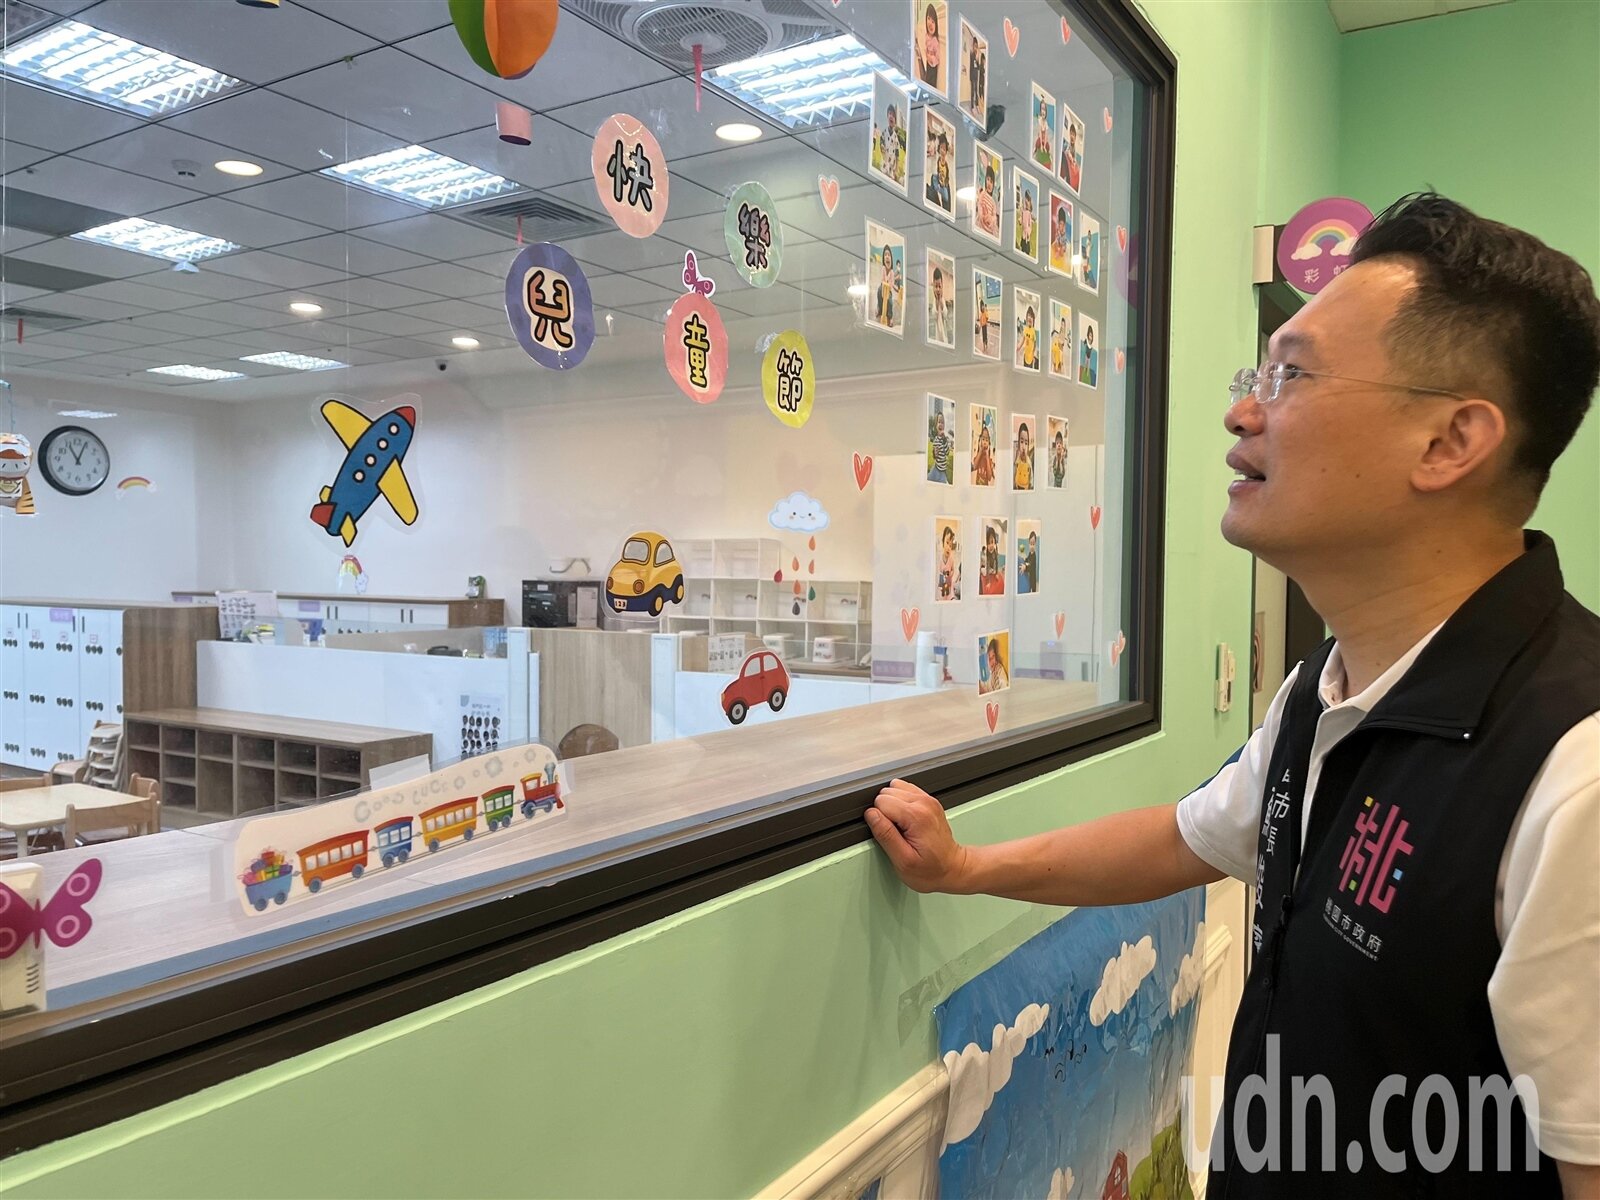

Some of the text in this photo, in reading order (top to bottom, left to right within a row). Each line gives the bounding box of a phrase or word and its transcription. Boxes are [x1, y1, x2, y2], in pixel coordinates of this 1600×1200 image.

[606, 139, 653, 212] 快
[738, 203, 770, 269] 樂
[526, 270, 573, 349] 兒
[684, 314, 710, 388] 童
[777, 349, 803, 412] 節
